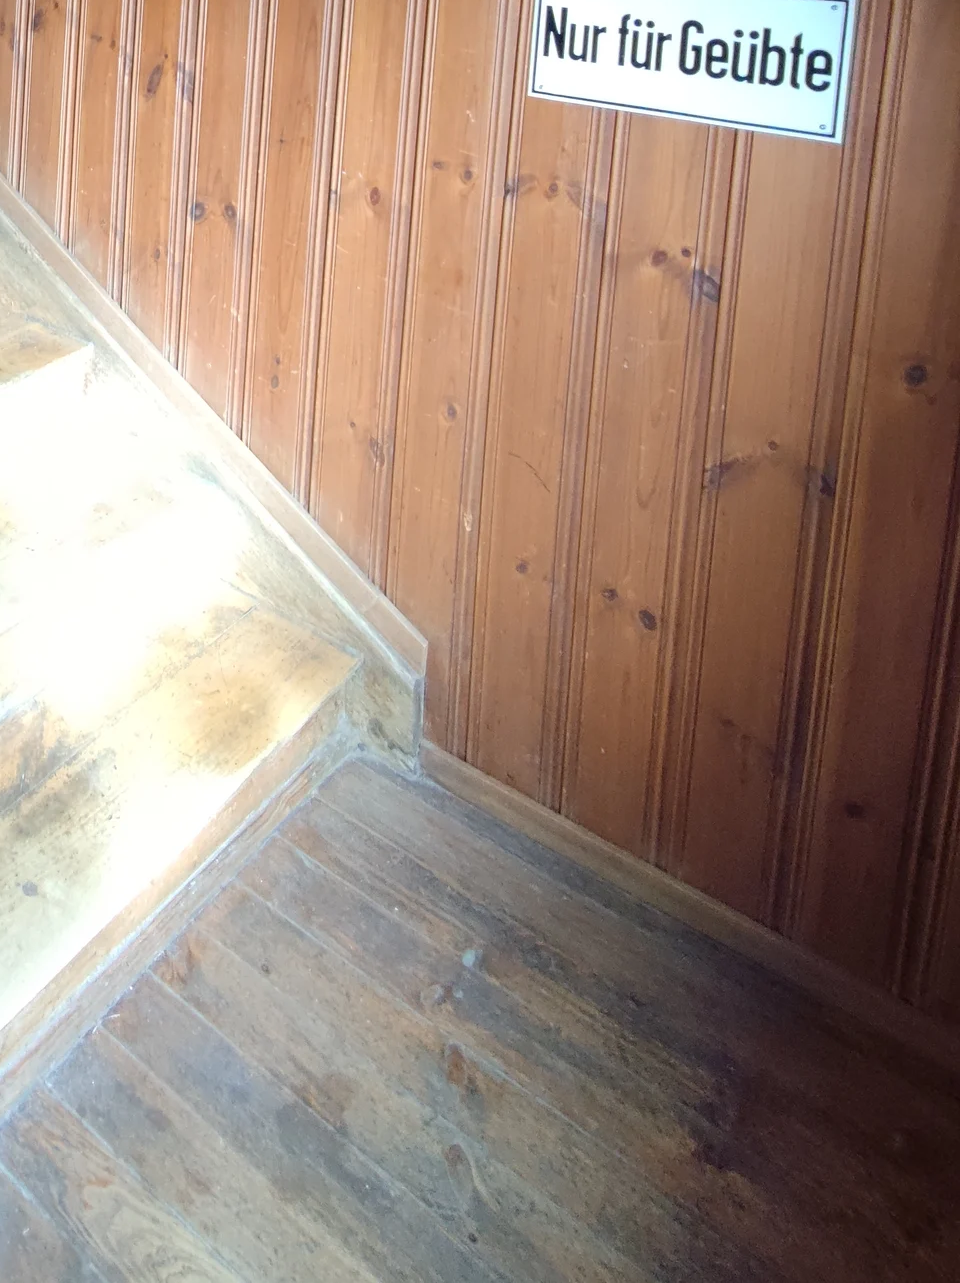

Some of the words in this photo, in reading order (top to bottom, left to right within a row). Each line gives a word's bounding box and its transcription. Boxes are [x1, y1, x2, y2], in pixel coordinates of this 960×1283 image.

[543, 5, 607, 64] Nur
[617, 13, 672, 71] für
[678, 19, 833, 93] Geübte
